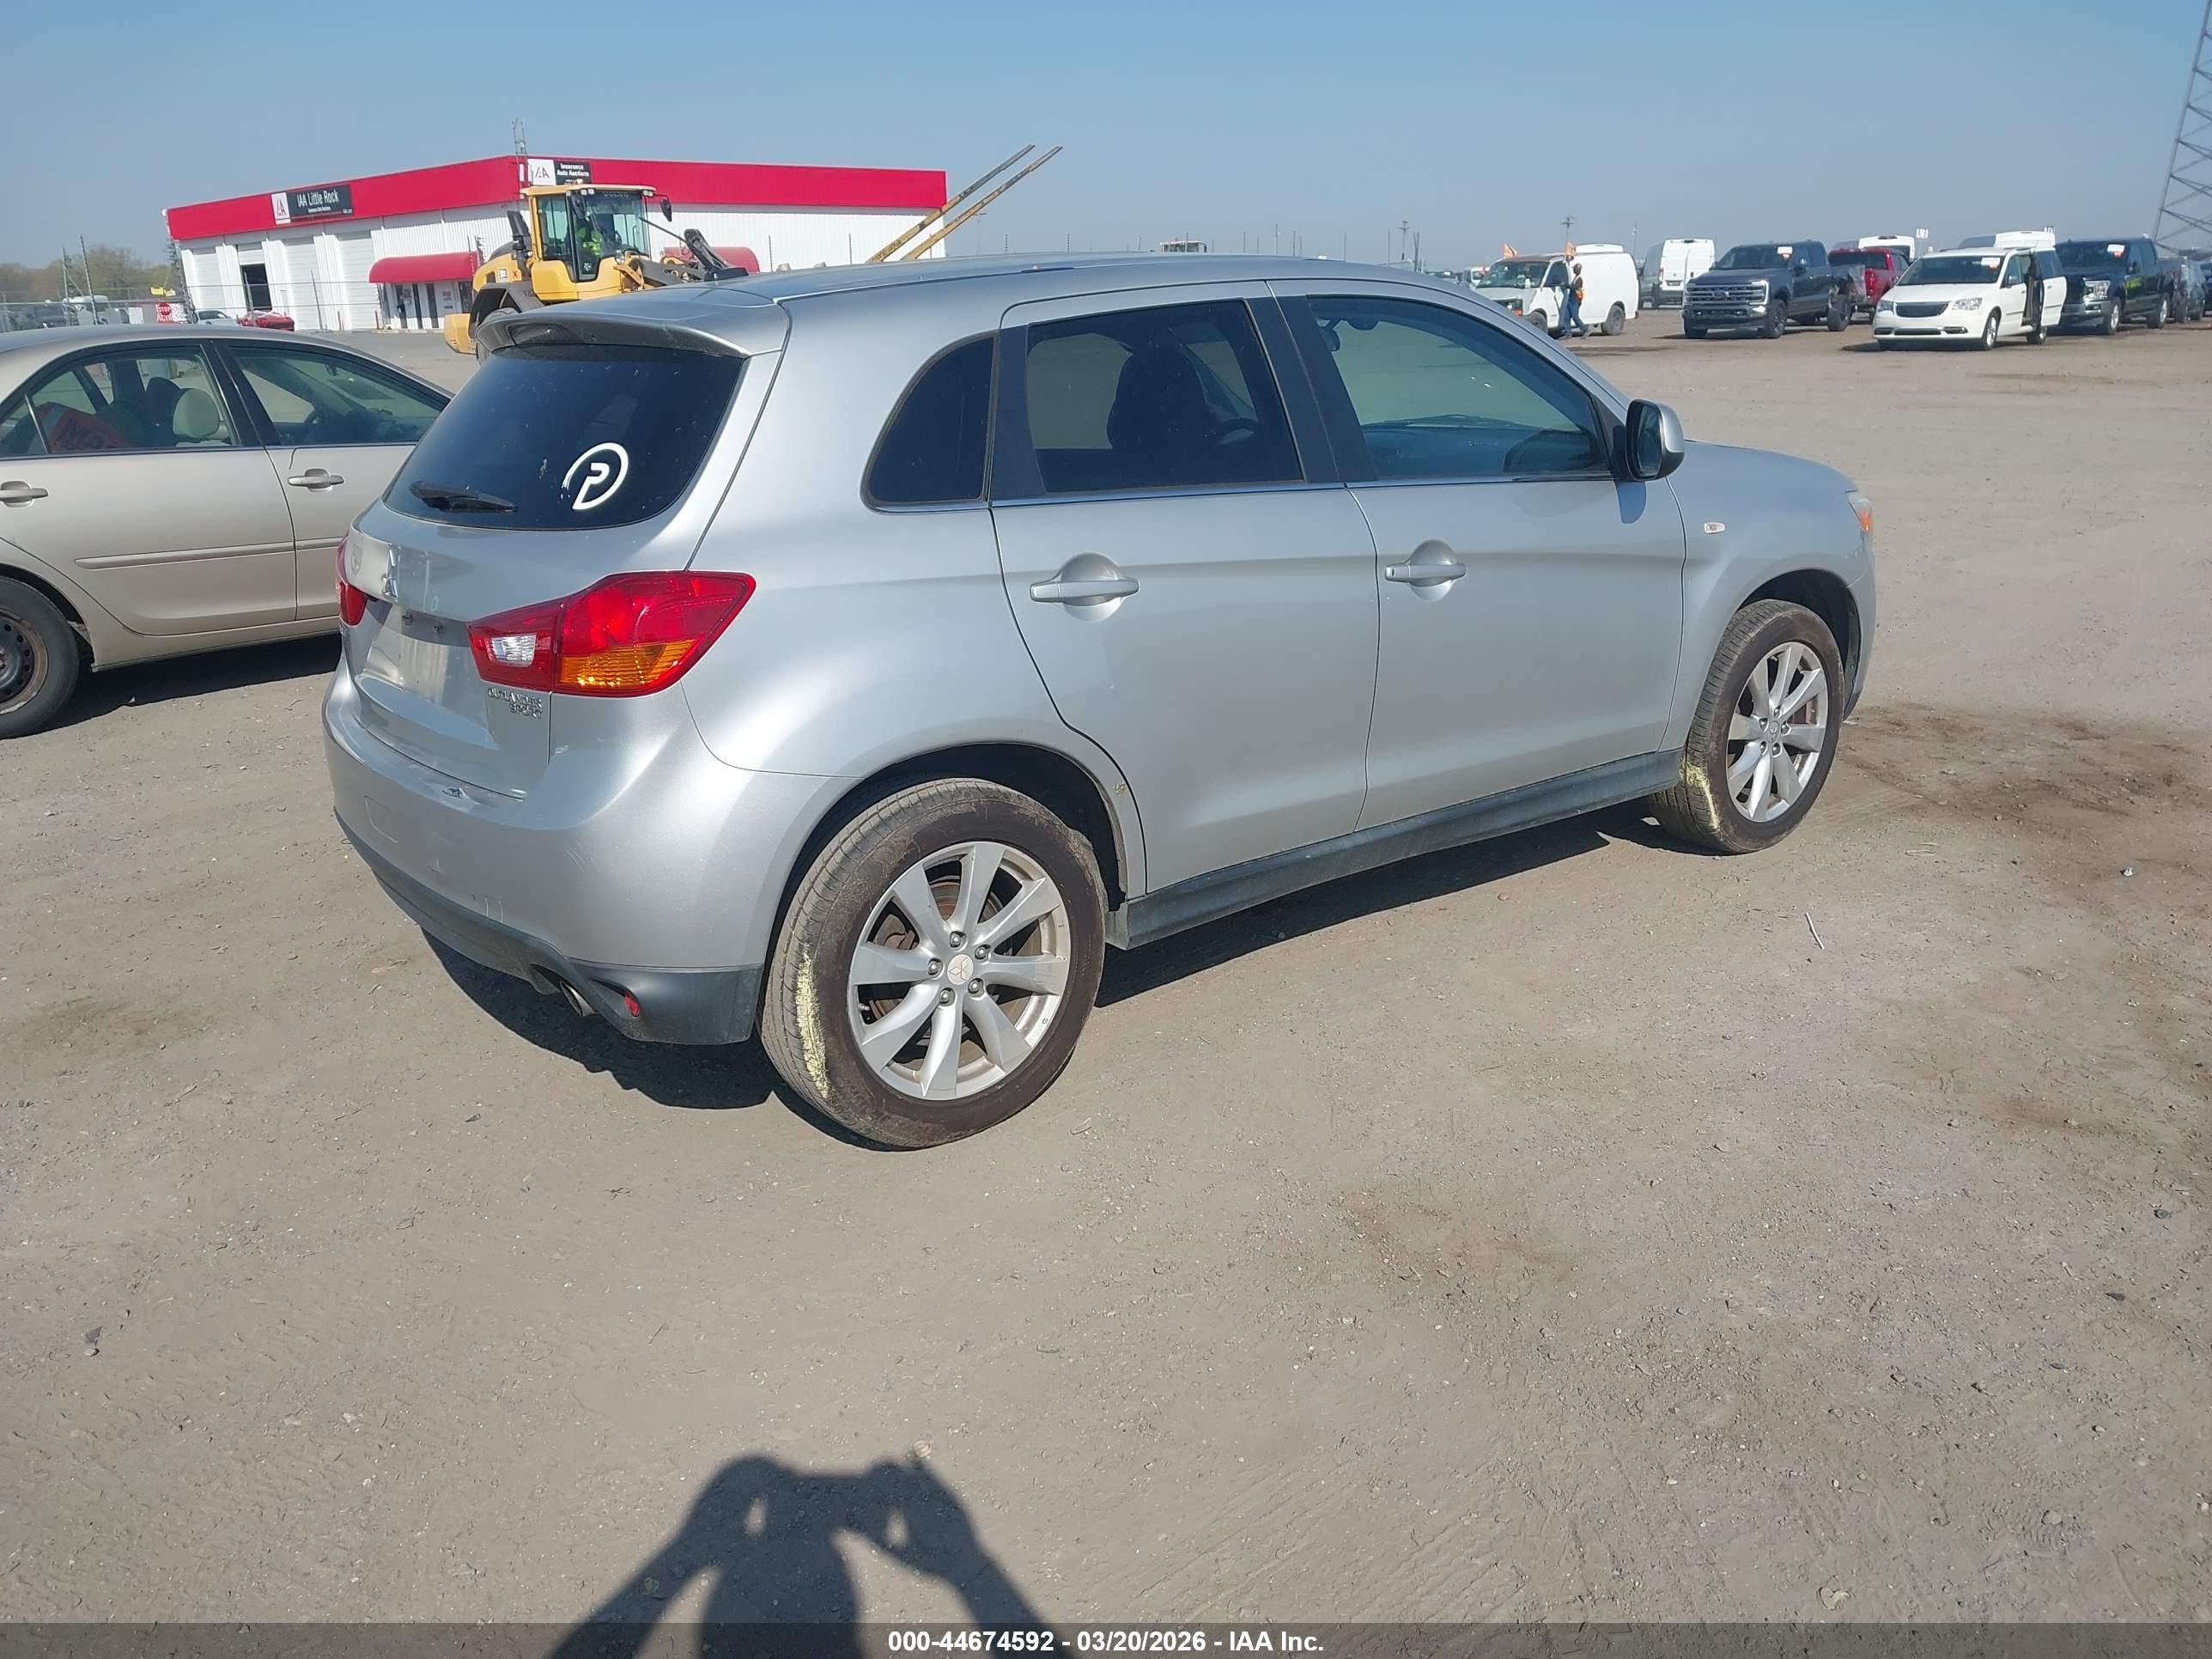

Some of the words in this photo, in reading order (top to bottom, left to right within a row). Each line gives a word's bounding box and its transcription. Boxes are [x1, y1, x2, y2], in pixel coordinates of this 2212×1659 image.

[296, 192, 308, 207] IAA
[307, 190, 324, 206] Little
[323, 188, 340, 204] Rock
[509, 703, 543, 719] SPORT
